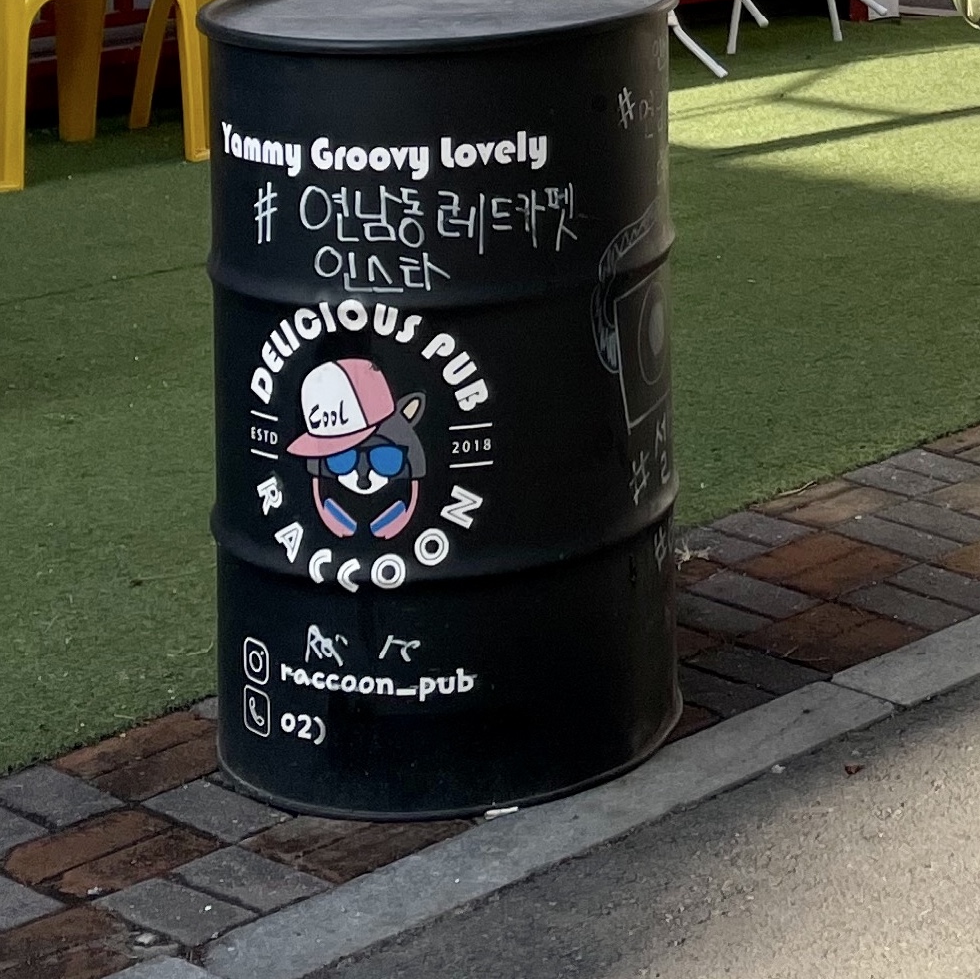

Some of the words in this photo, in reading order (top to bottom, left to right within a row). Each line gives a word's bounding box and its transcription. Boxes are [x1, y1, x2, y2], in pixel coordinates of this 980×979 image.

[221, 121, 302, 177] Yammy
[310, 136, 430, 180] Groovy
[440, 130, 548, 170] Lovely
[314, 245, 451, 293] 인스타
[250, 298, 423, 405] DELICIOUS
[421, 332, 490, 412] PUB
[308, 400, 349, 429] Cool
[250, 426, 278, 445] ESTD
[451, 438, 492, 454] 2018
[256, 476, 484, 593] RACCOON
[280, 663, 476, 702] raccoon_pub
[280, 712, 326, 745] 02)
